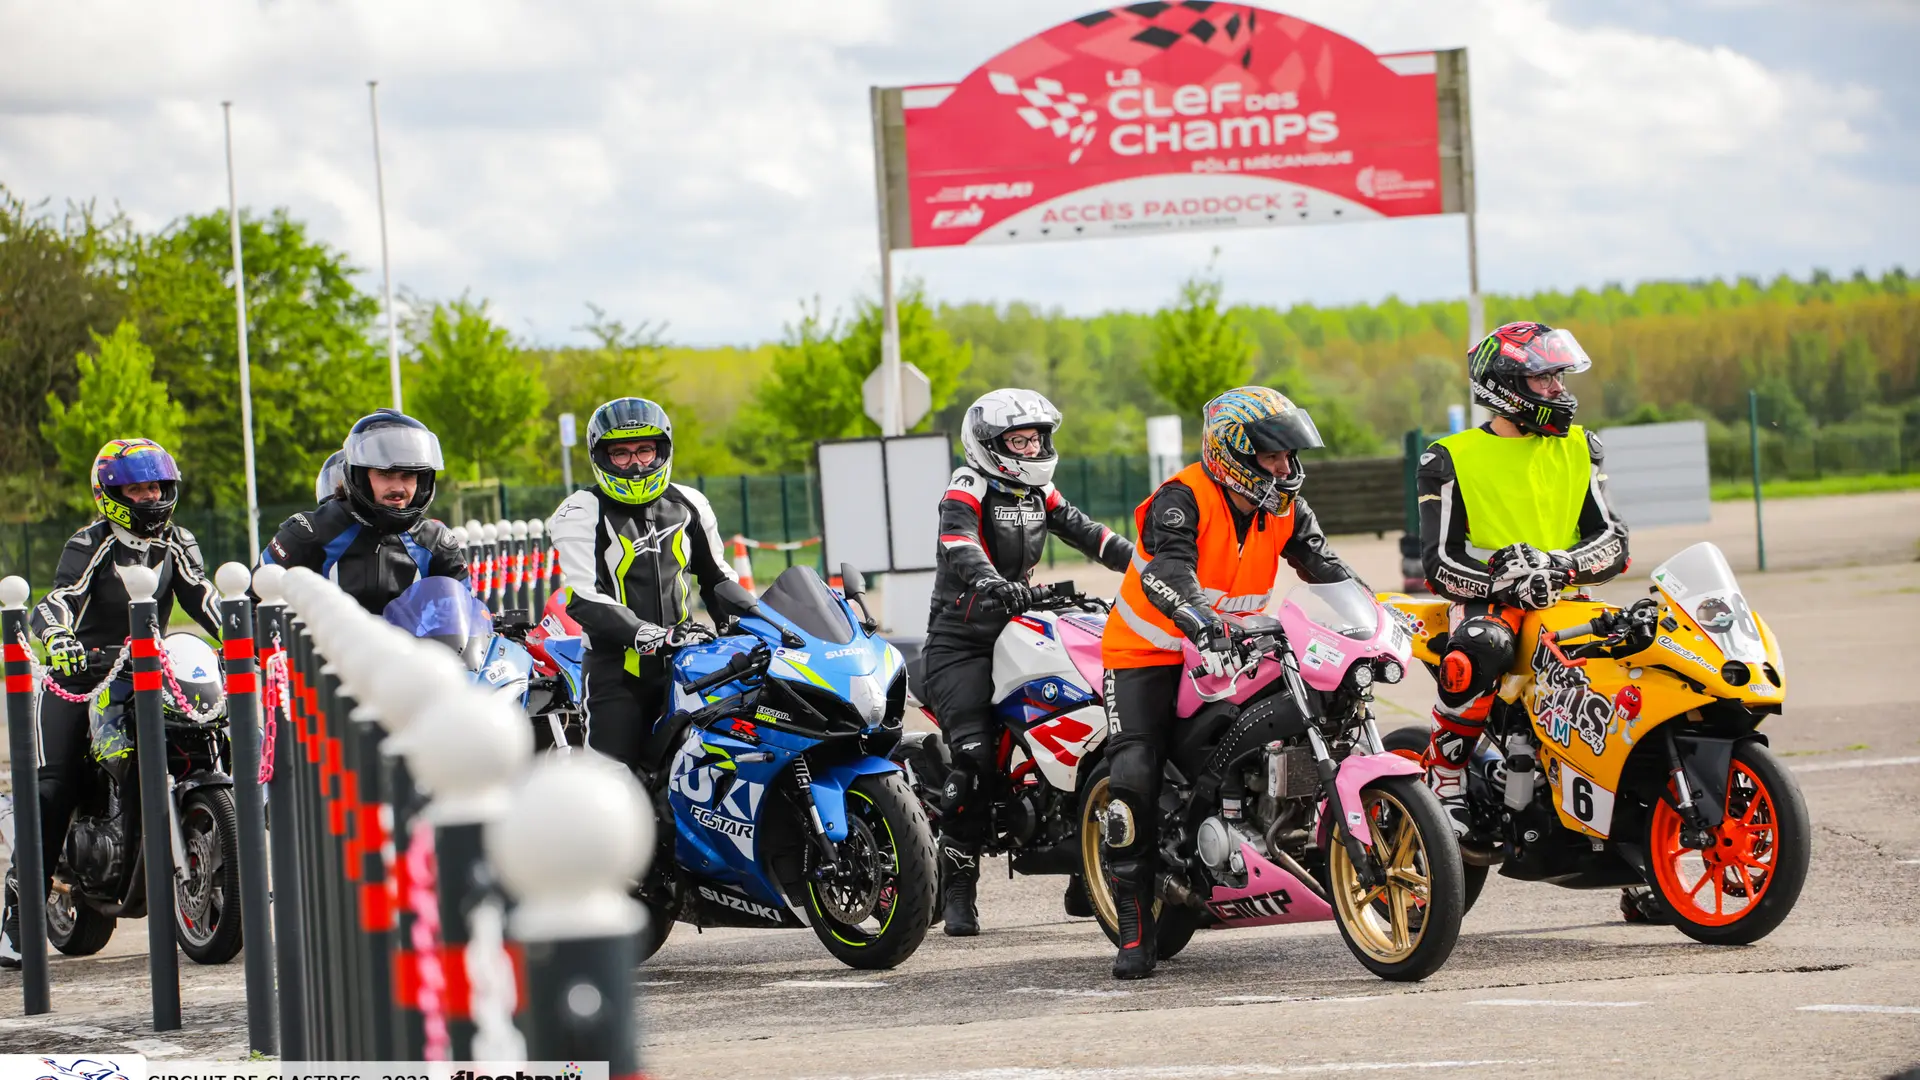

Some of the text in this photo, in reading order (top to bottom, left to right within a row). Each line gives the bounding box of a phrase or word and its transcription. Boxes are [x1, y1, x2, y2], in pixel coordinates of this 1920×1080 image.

[1191, 150, 1353, 173] PÔLE MÉCANIQUE
[1041, 200, 1134, 224] ACCÈS
[1143, 193, 1281, 217] PADDOCK
[1291, 192, 1309, 209] 2
[1437, 568, 1487, 597] MONSTERS
[1572, 776, 1594, 822] 6
[690, 805, 755, 839] ECSTAR
[698, 886, 782, 922] SUZUKI
